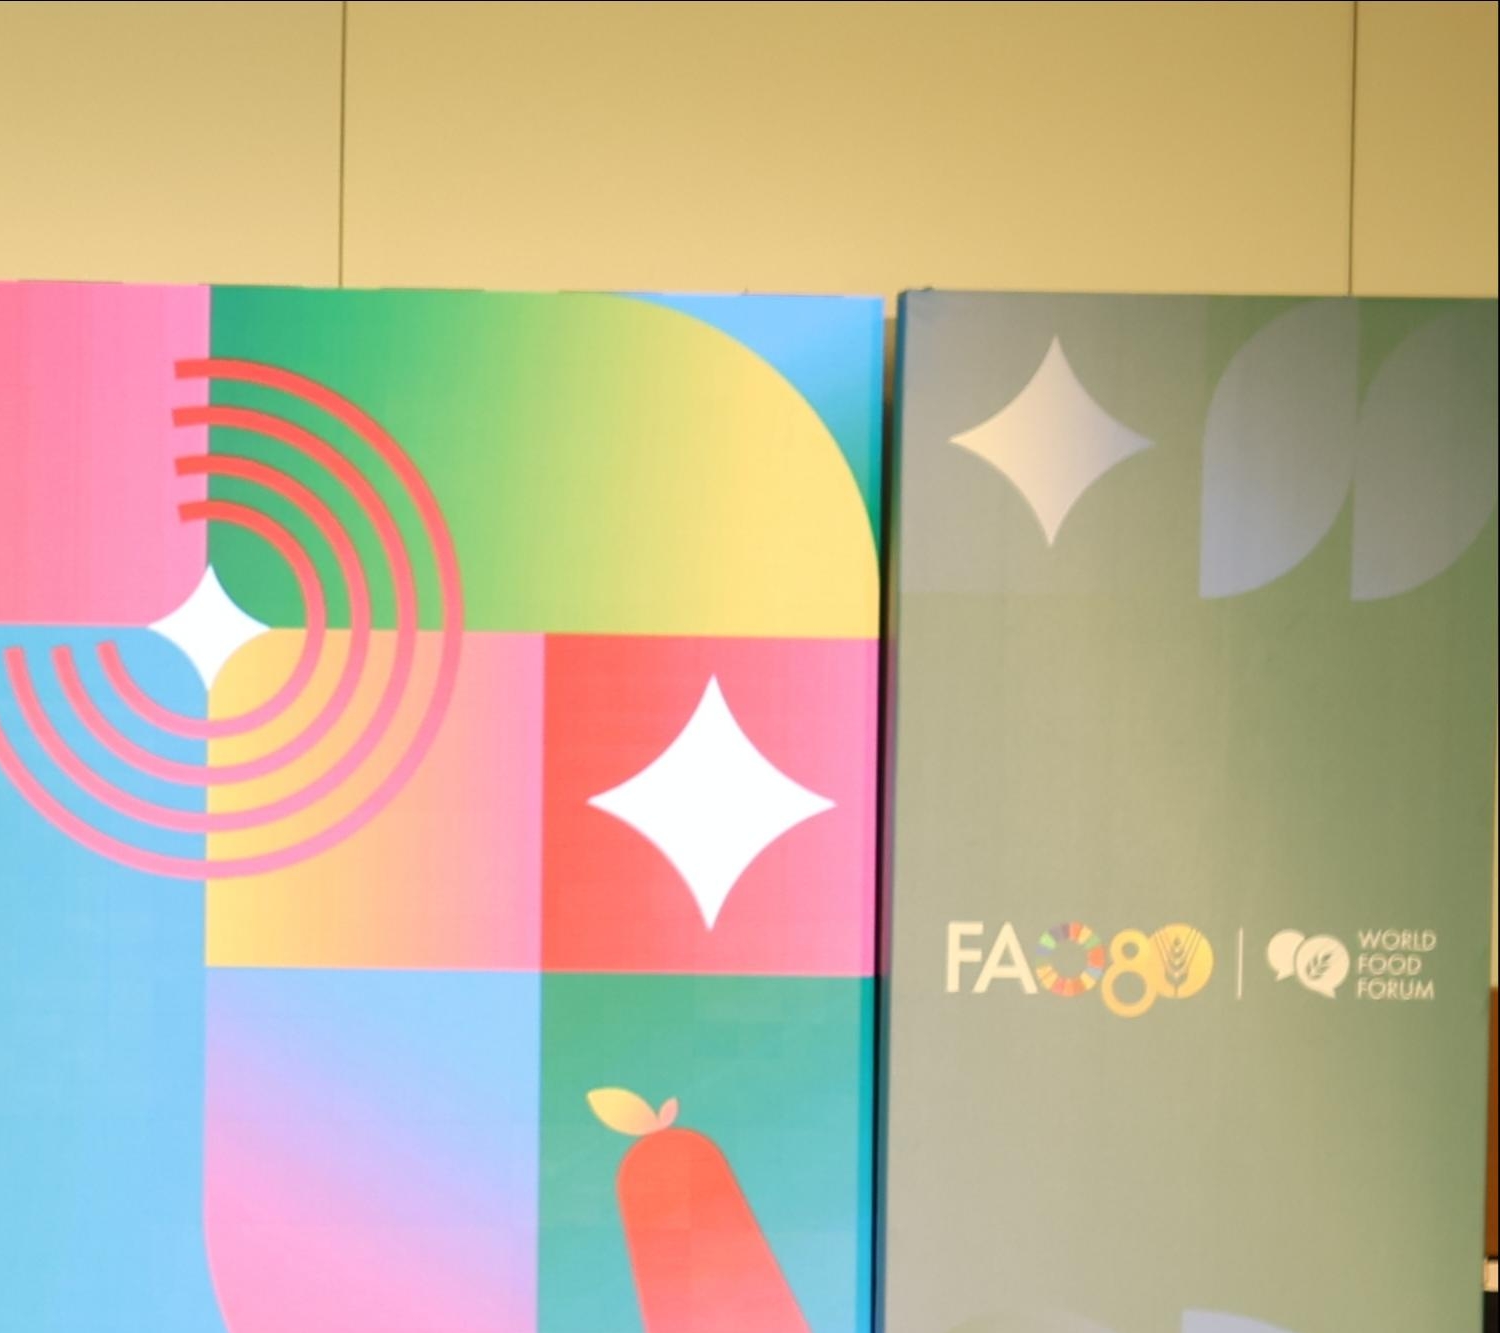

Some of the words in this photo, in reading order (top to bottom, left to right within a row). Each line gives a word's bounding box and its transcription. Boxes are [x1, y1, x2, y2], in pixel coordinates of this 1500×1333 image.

[1357, 929, 1437, 952] WORLD
[1357, 954, 1422, 976] FOOD
[1357, 977, 1435, 1000] FORUM
